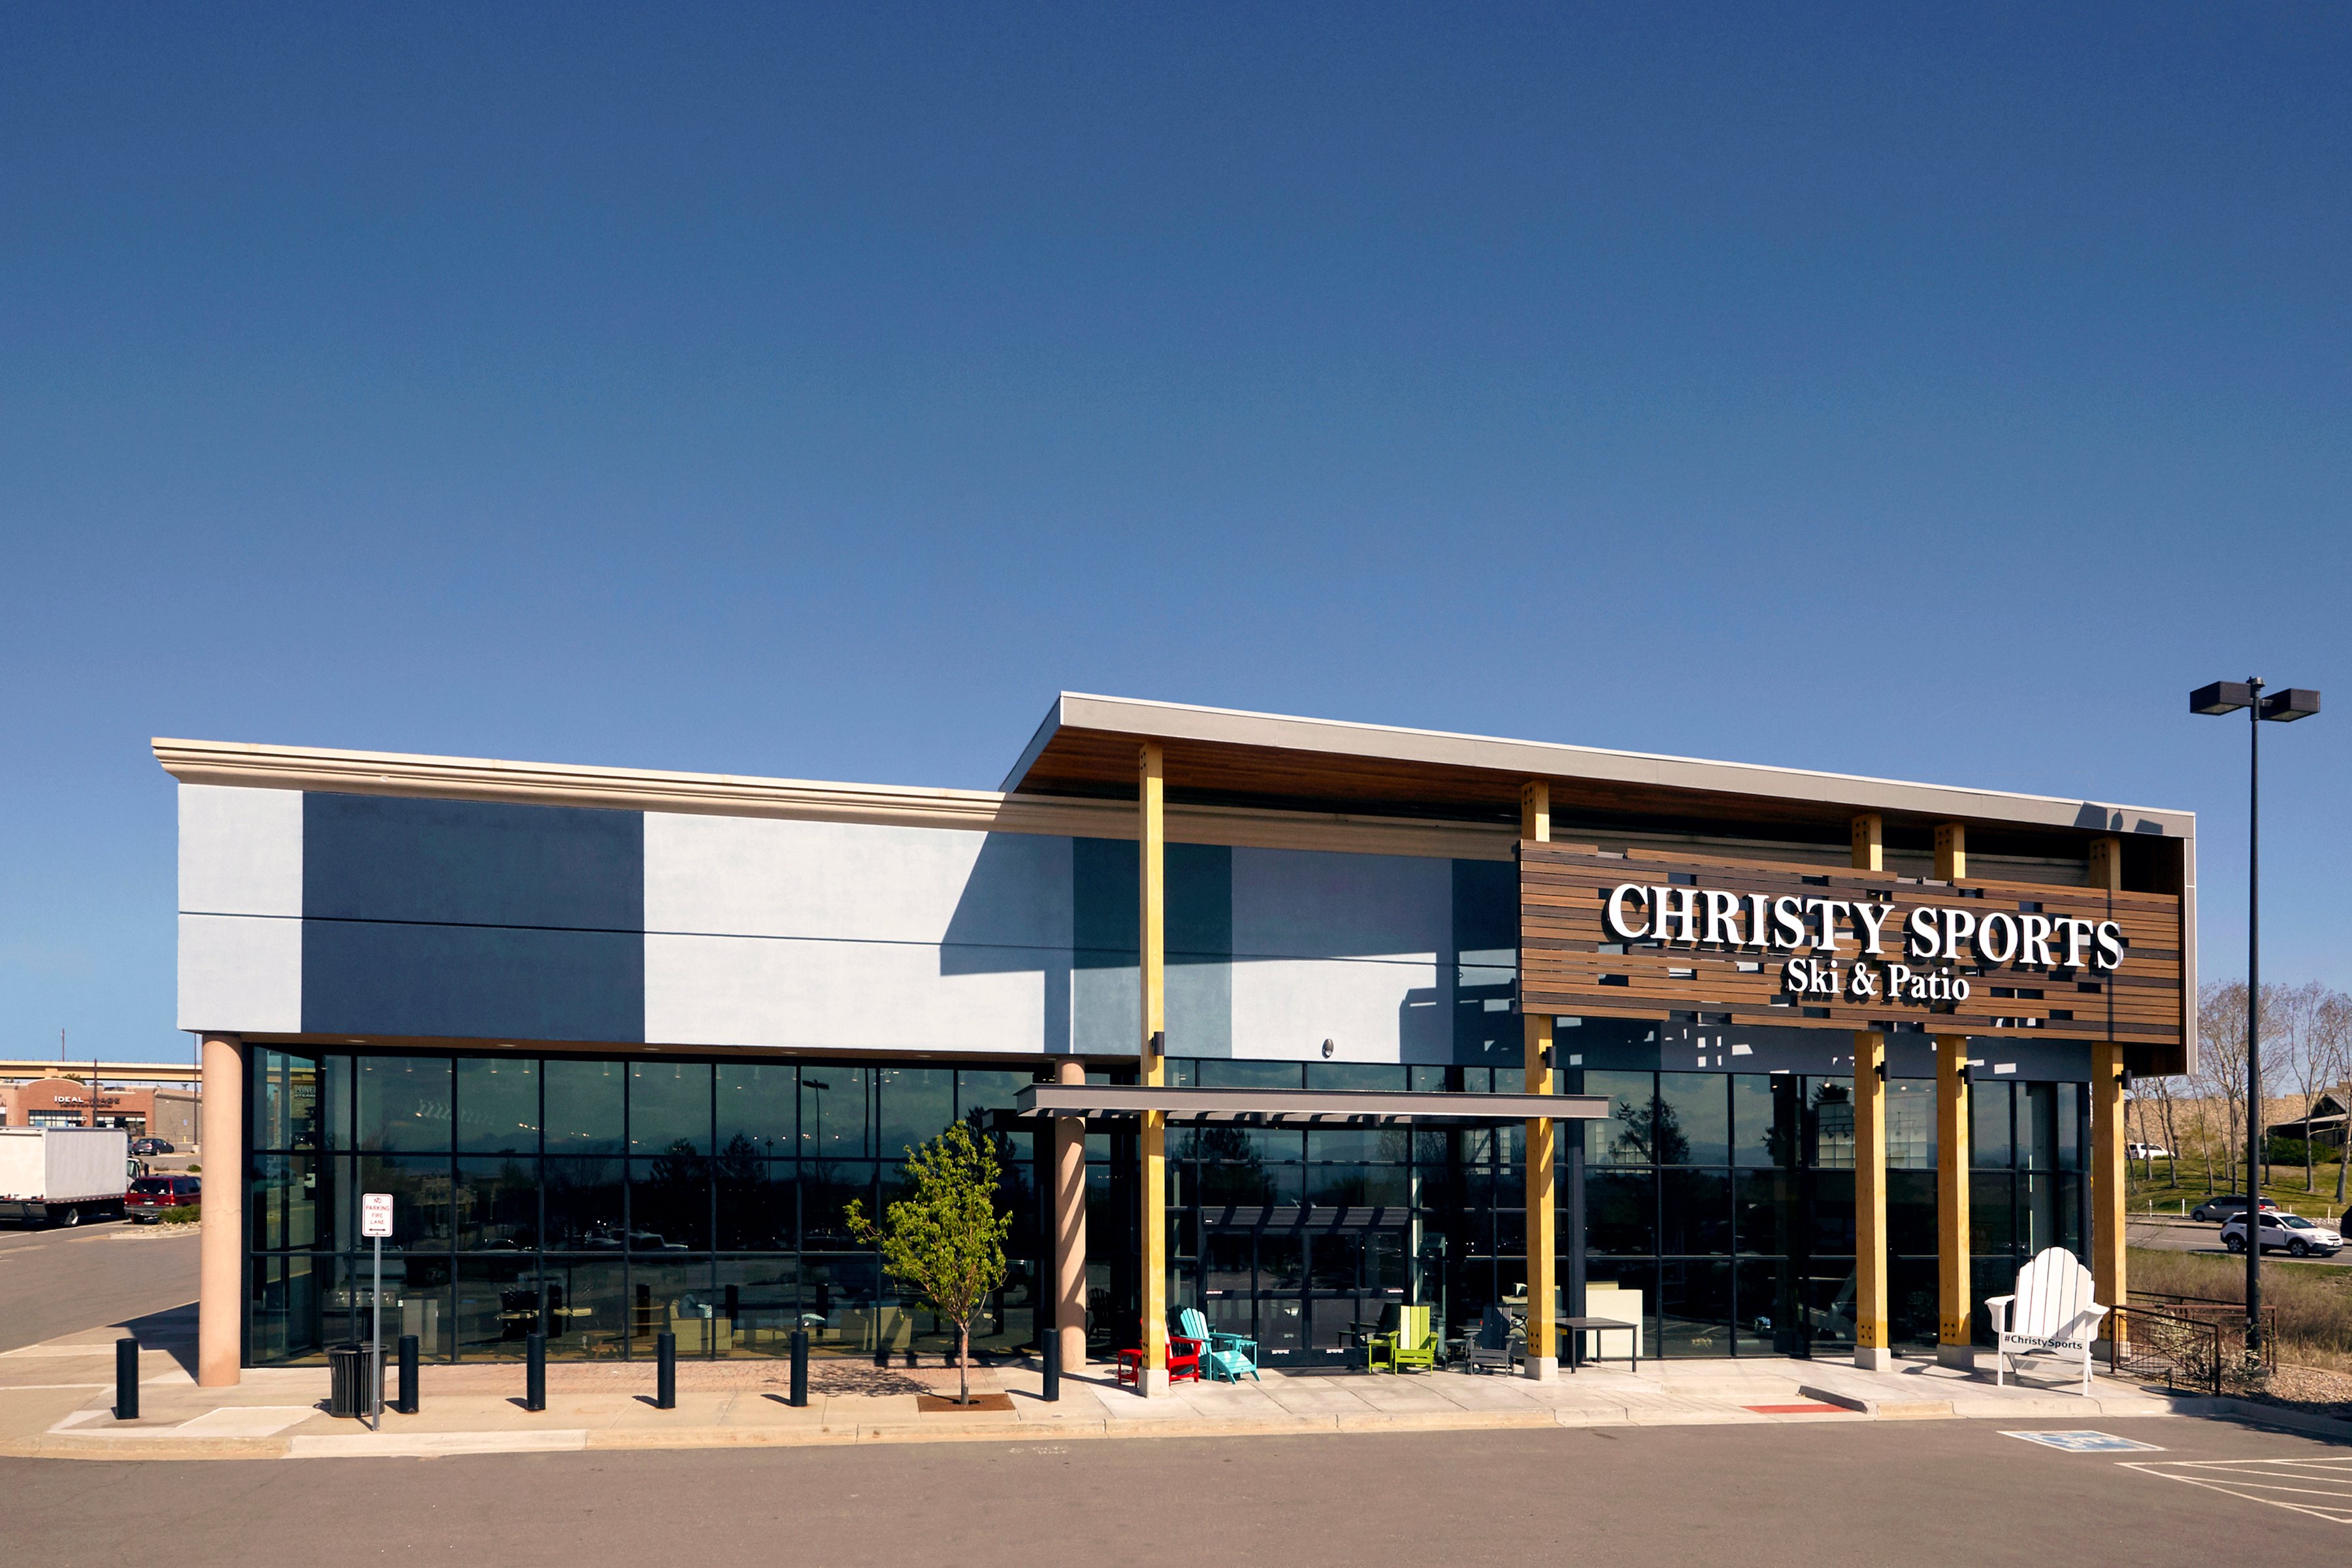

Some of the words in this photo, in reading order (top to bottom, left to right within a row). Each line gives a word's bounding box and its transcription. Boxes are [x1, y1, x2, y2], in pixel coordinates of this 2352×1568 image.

[1609, 883, 1895, 954] CHRISTY
[1911, 907, 2124, 970] SPORTS
[1788, 958, 1840, 994] Ski
[1852, 962, 1878, 996] &
[1887, 964, 1970, 1001] Patio
[2004, 1335, 2083, 1350] #ChristySports
